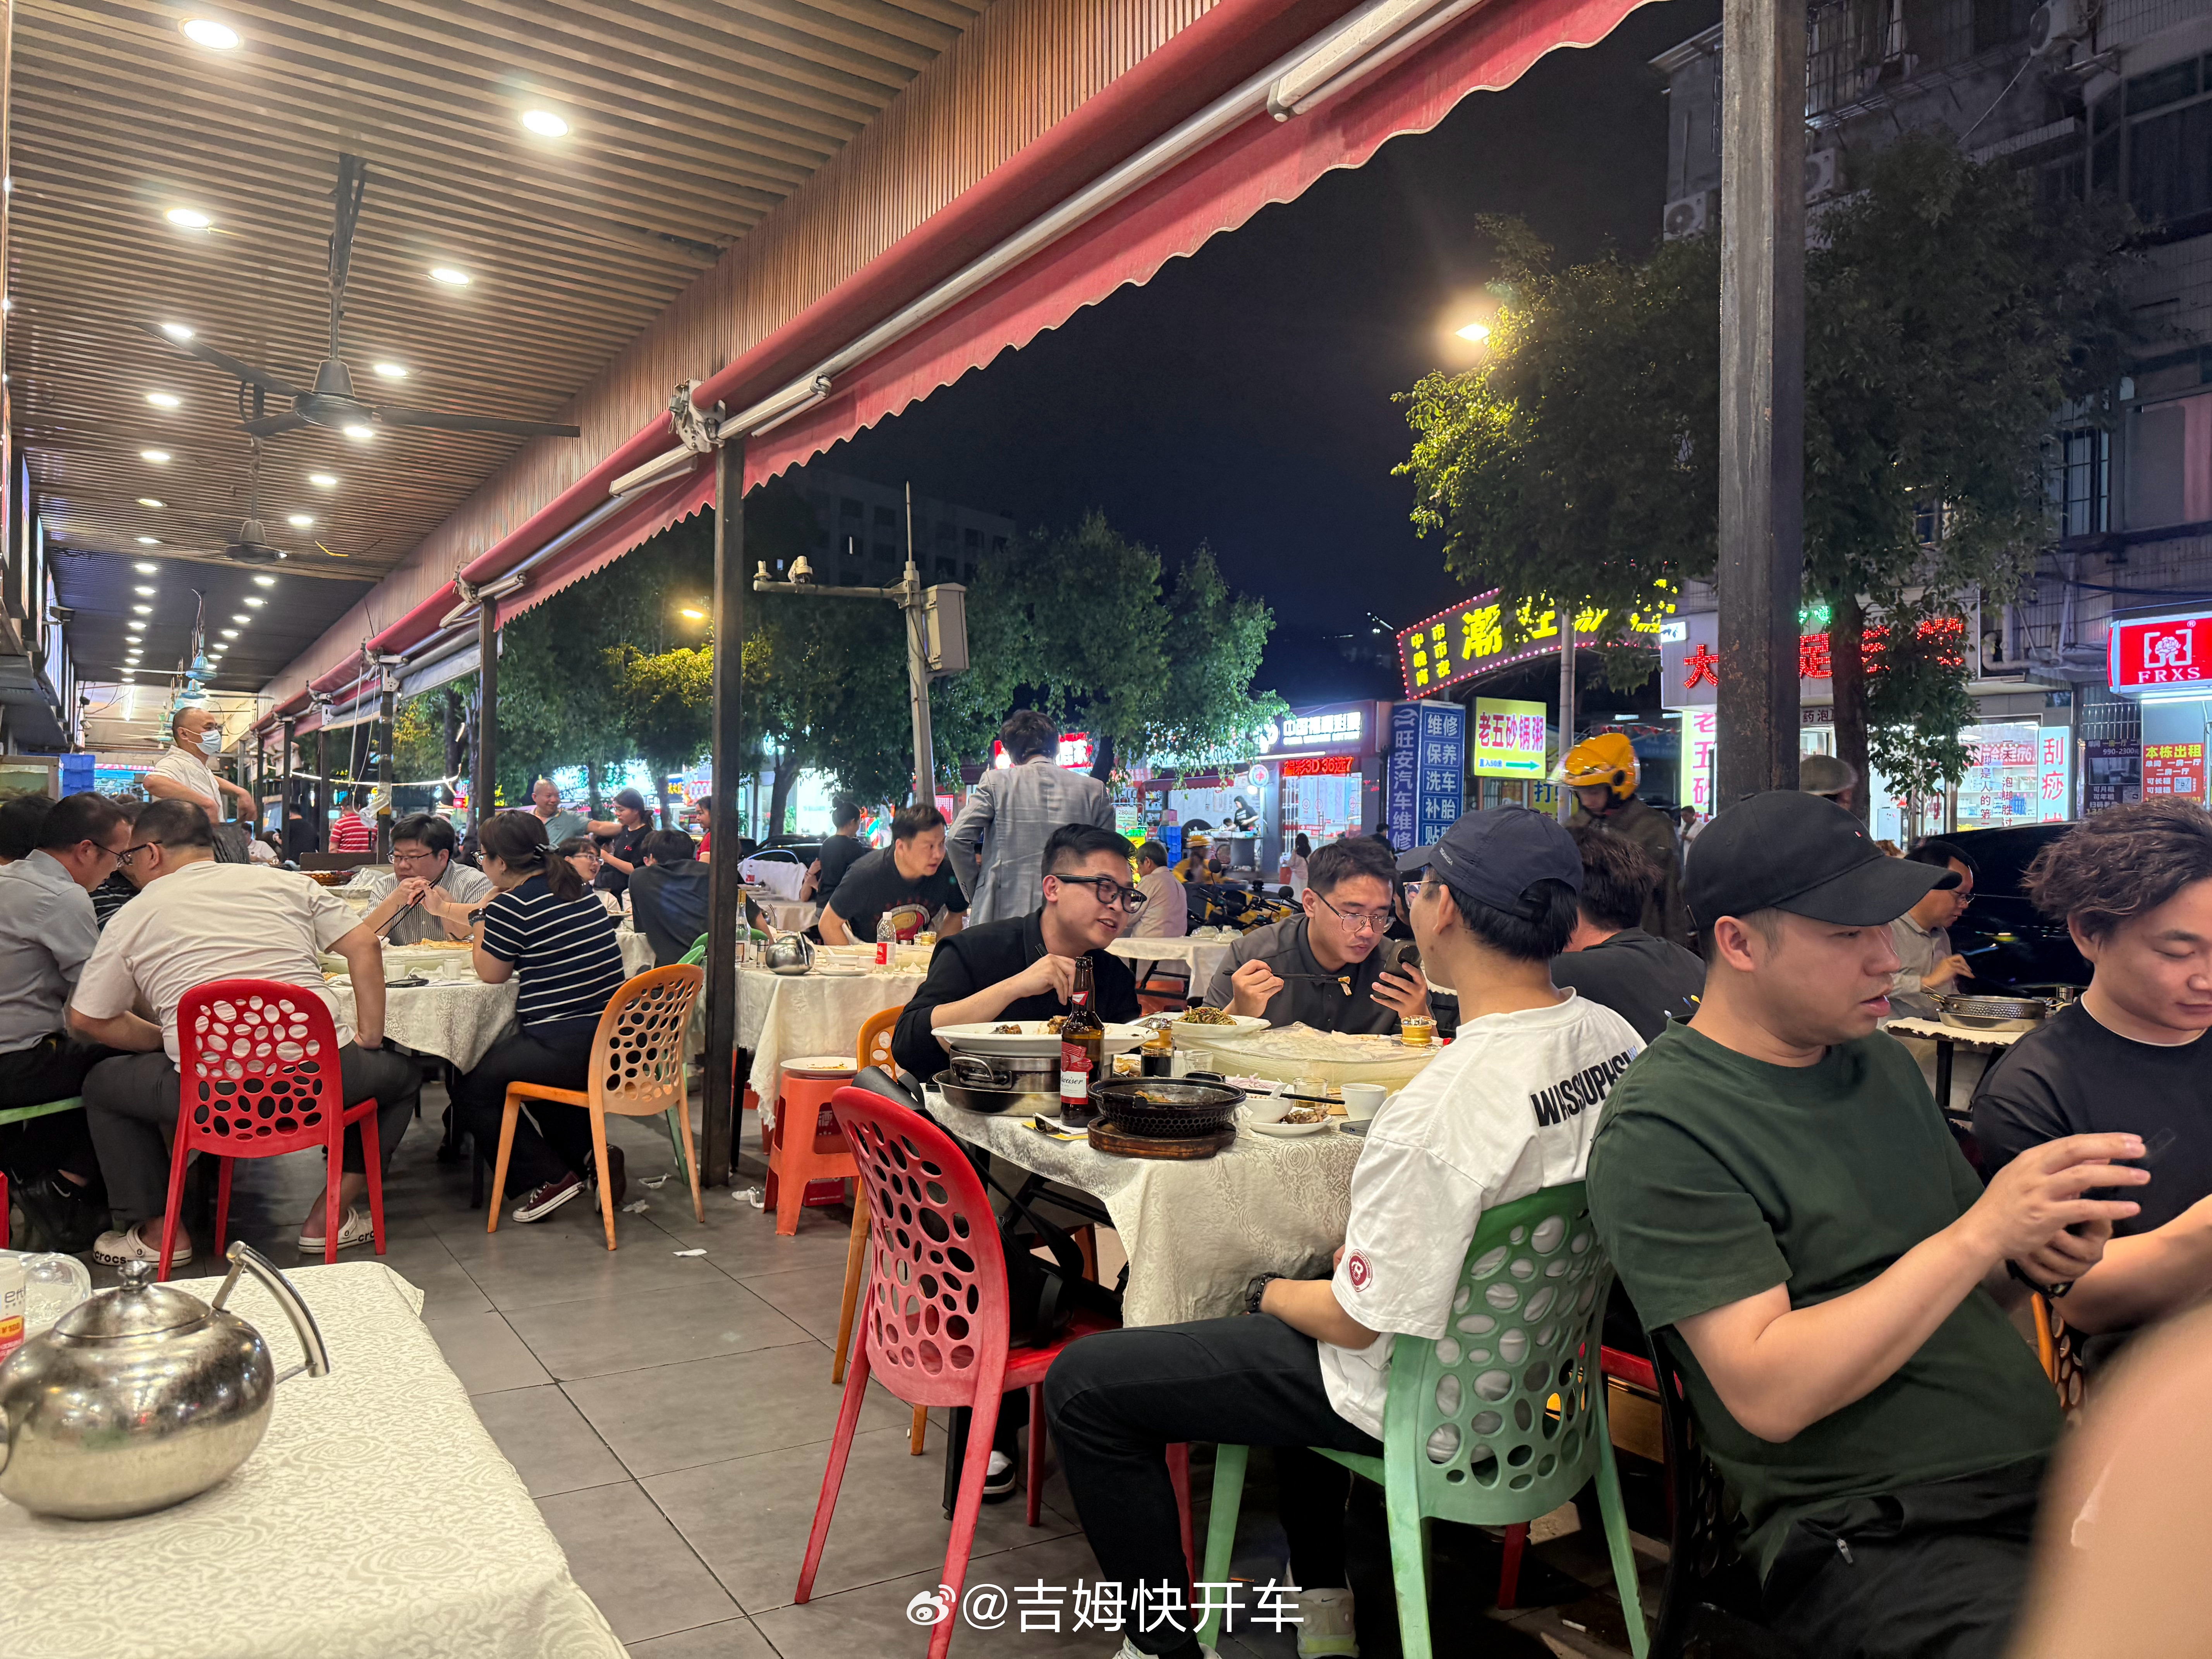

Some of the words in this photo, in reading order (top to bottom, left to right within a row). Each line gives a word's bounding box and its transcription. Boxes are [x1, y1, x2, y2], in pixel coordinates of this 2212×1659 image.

[2138, 667, 2201, 684] FRXS
[1427, 714, 1458, 737] 维修
[1803, 709, 1834, 723] 药泡
[1479, 712, 1544, 751] 老五砂锅粥
[1427, 742, 1457, 765] 保养
[2145, 744, 2202, 759] 本栋出租
[1693, 714, 1716, 823] 老五砂
[1392, 730, 1414, 851] 旺安汽车维修
[1426, 770, 1456, 792] 洗车
[2041, 737, 2064, 823] 刮痧
[1425, 798, 1455, 819] 补胎
[94, 1251, 126, 1264] crocs
